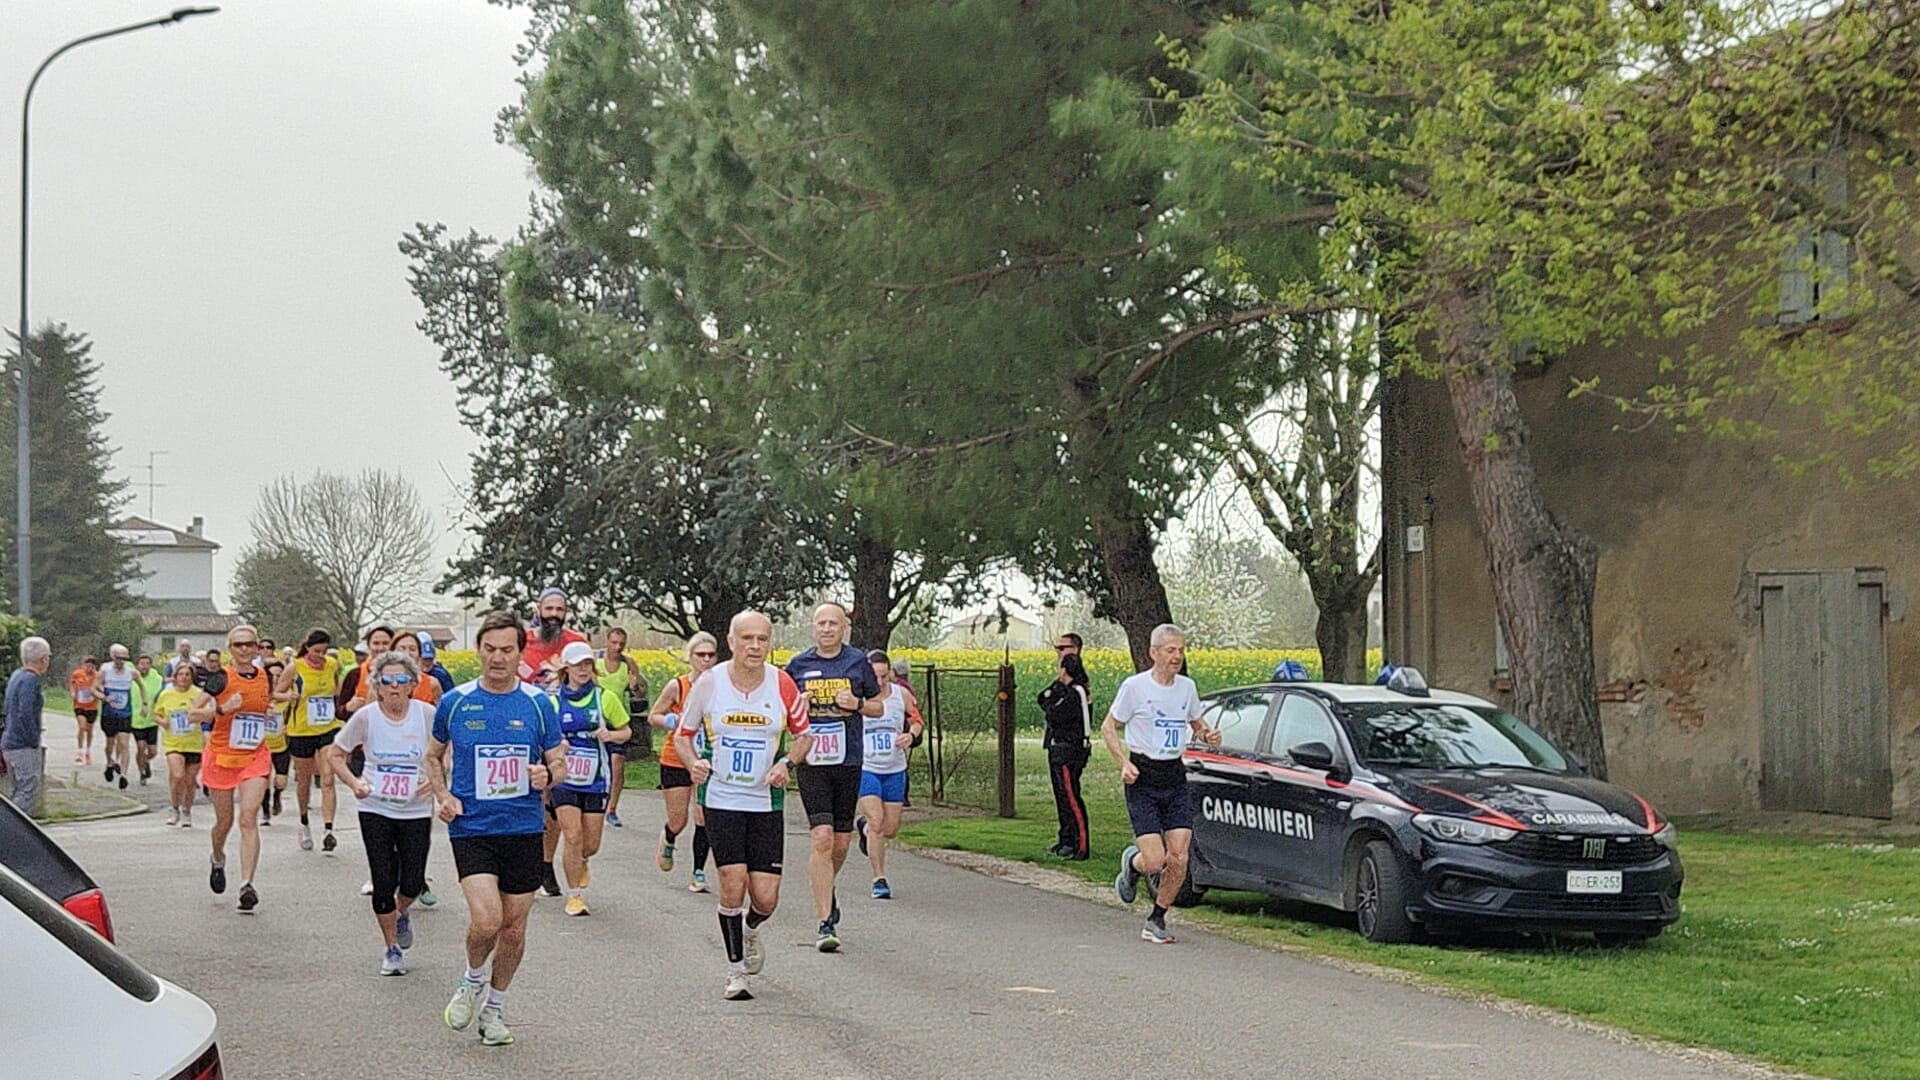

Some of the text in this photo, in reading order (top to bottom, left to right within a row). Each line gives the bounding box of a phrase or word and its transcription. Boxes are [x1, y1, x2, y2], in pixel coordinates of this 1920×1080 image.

[241, 721, 260, 740] 112
[1164, 728, 1179, 748] 20
[814, 734, 839, 754] 284
[872, 733, 892, 751] 158
[487, 757, 519, 785] 240
[567, 756, 592, 776] 208
[732, 750, 753, 773] 80
[381, 775, 410, 796] 233
[1202, 795, 1314, 841] CARABINIERI
[1582, 838, 1607, 859] FIAT
